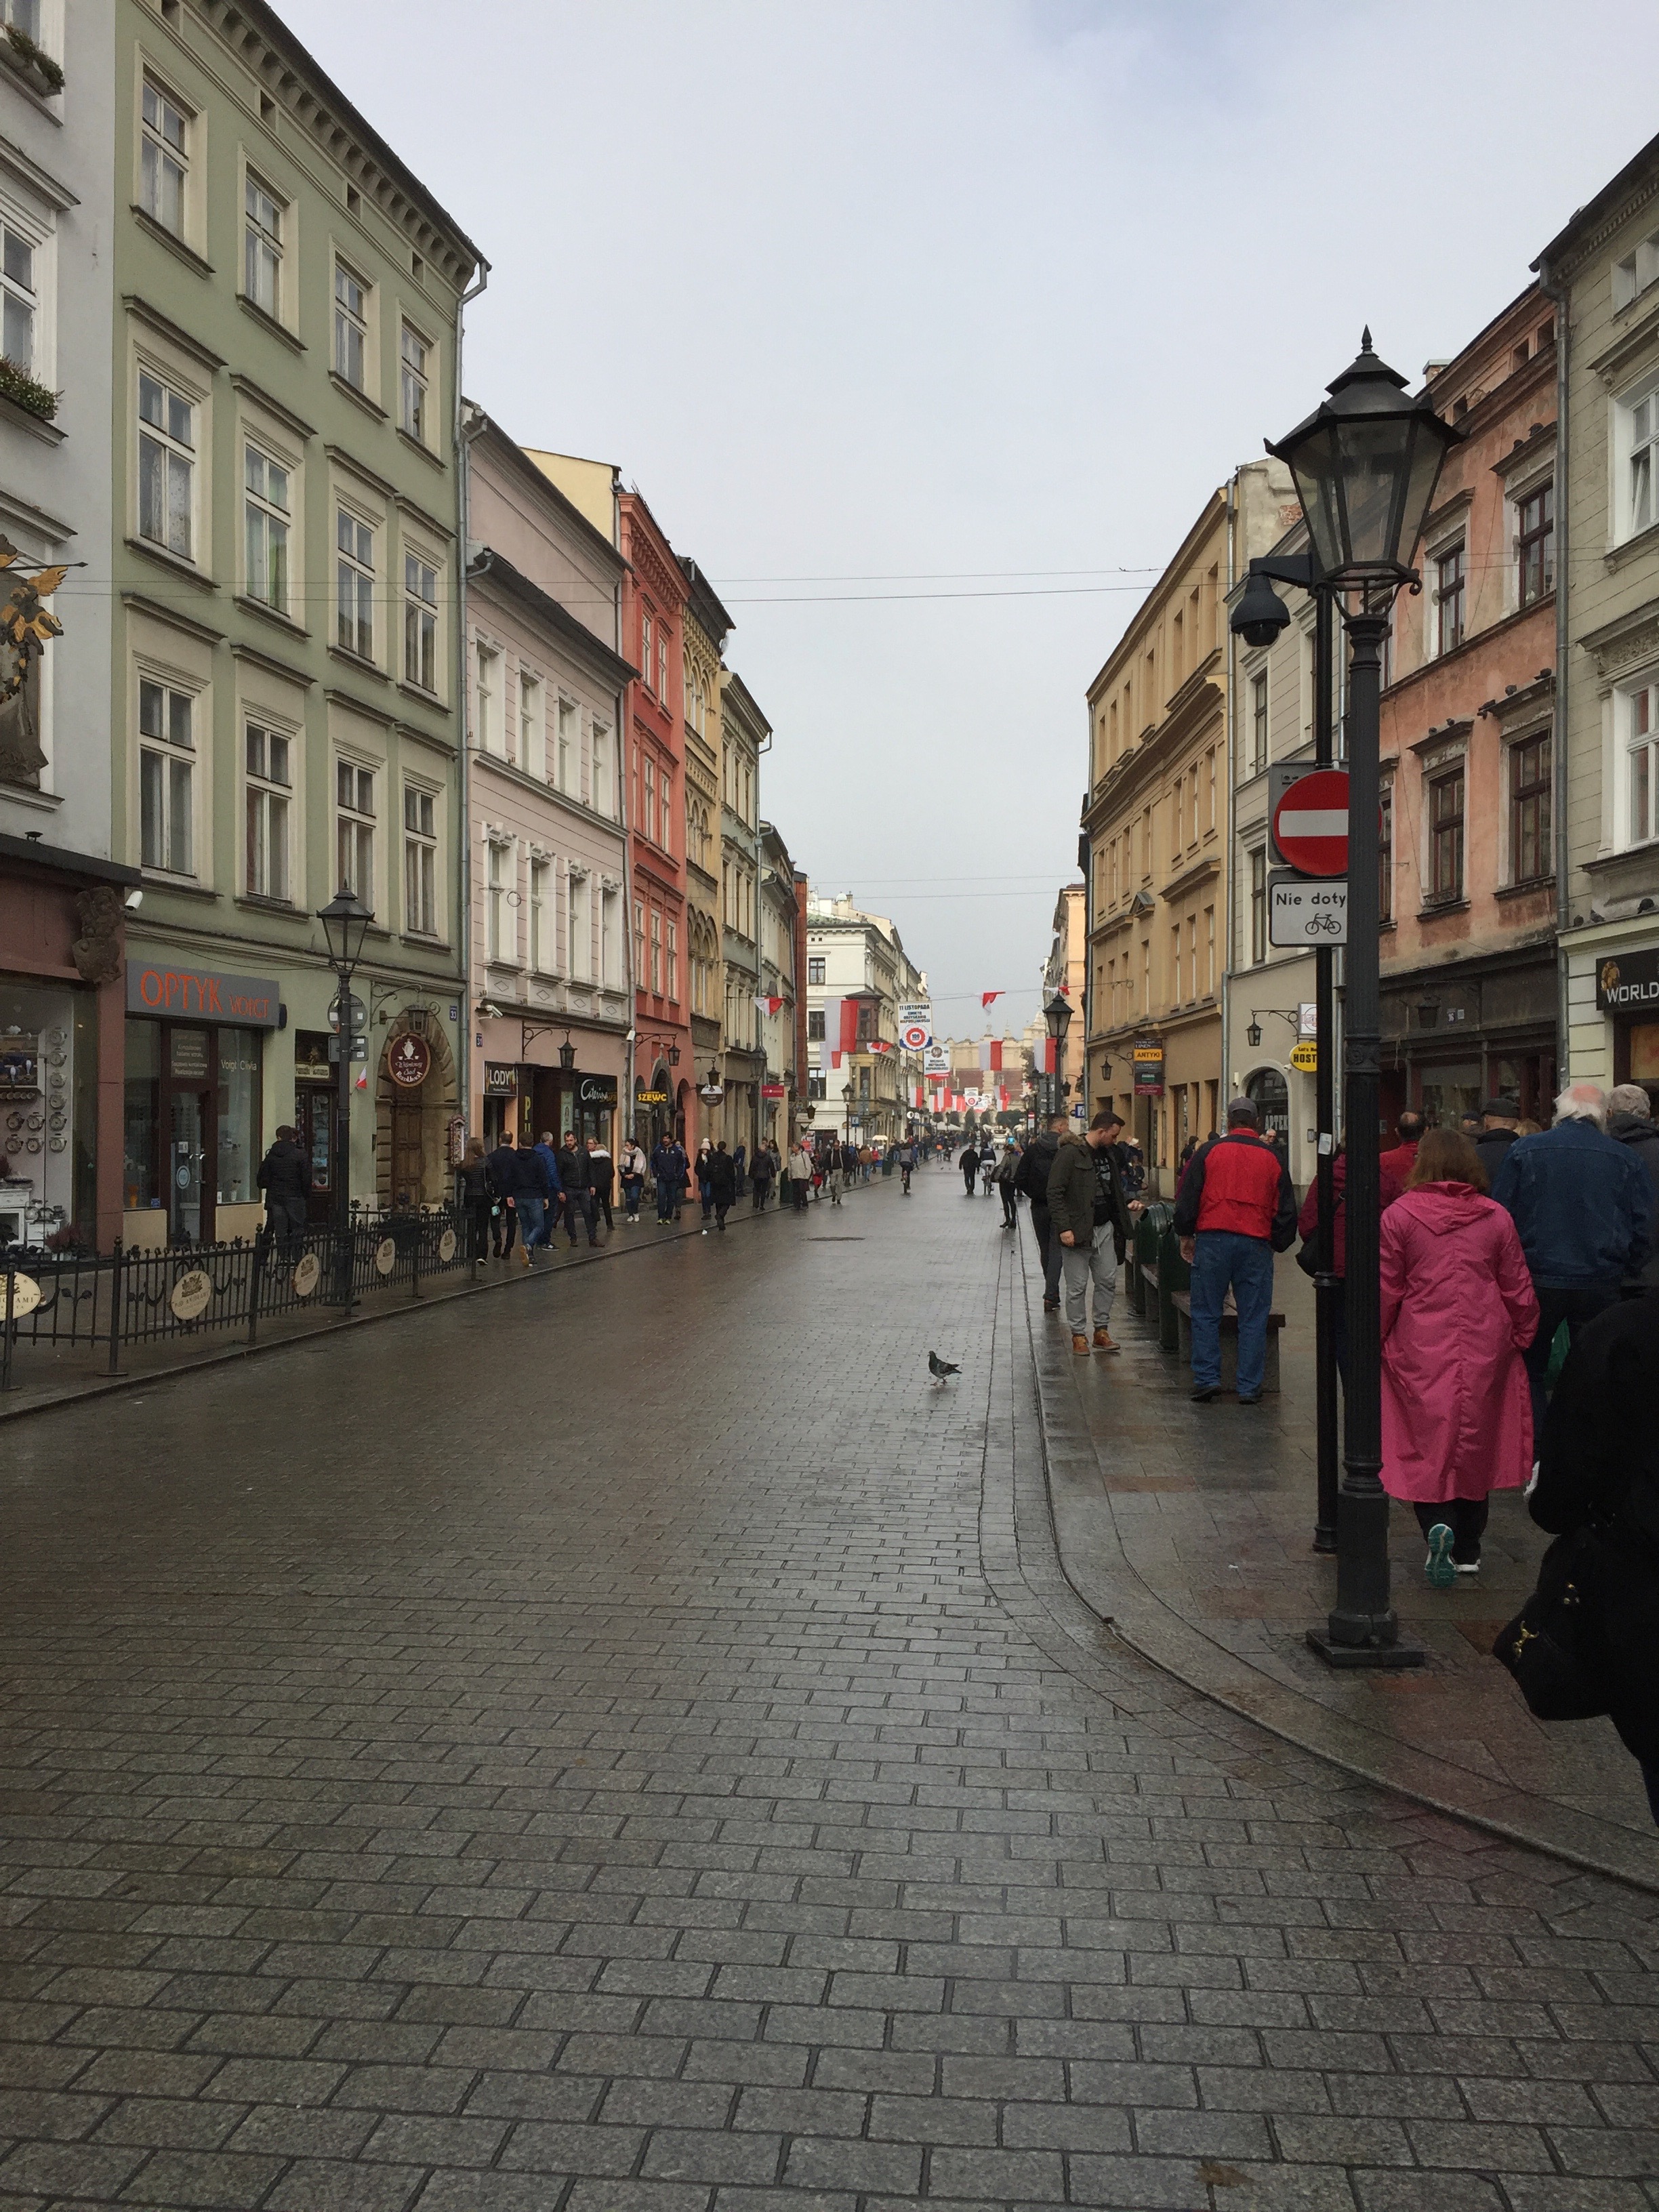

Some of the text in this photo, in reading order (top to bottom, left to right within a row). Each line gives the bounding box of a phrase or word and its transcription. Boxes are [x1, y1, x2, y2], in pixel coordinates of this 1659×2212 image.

[1276, 892, 1346, 908] Nie doty
[140, 970, 223, 1013] OPTYK
[1606, 981, 1659, 1003] WORLD
[1293, 1054, 1317, 1063] HOST
[490, 1069, 510, 1085] LODY
[638, 1093, 667, 1101] SZEWC
